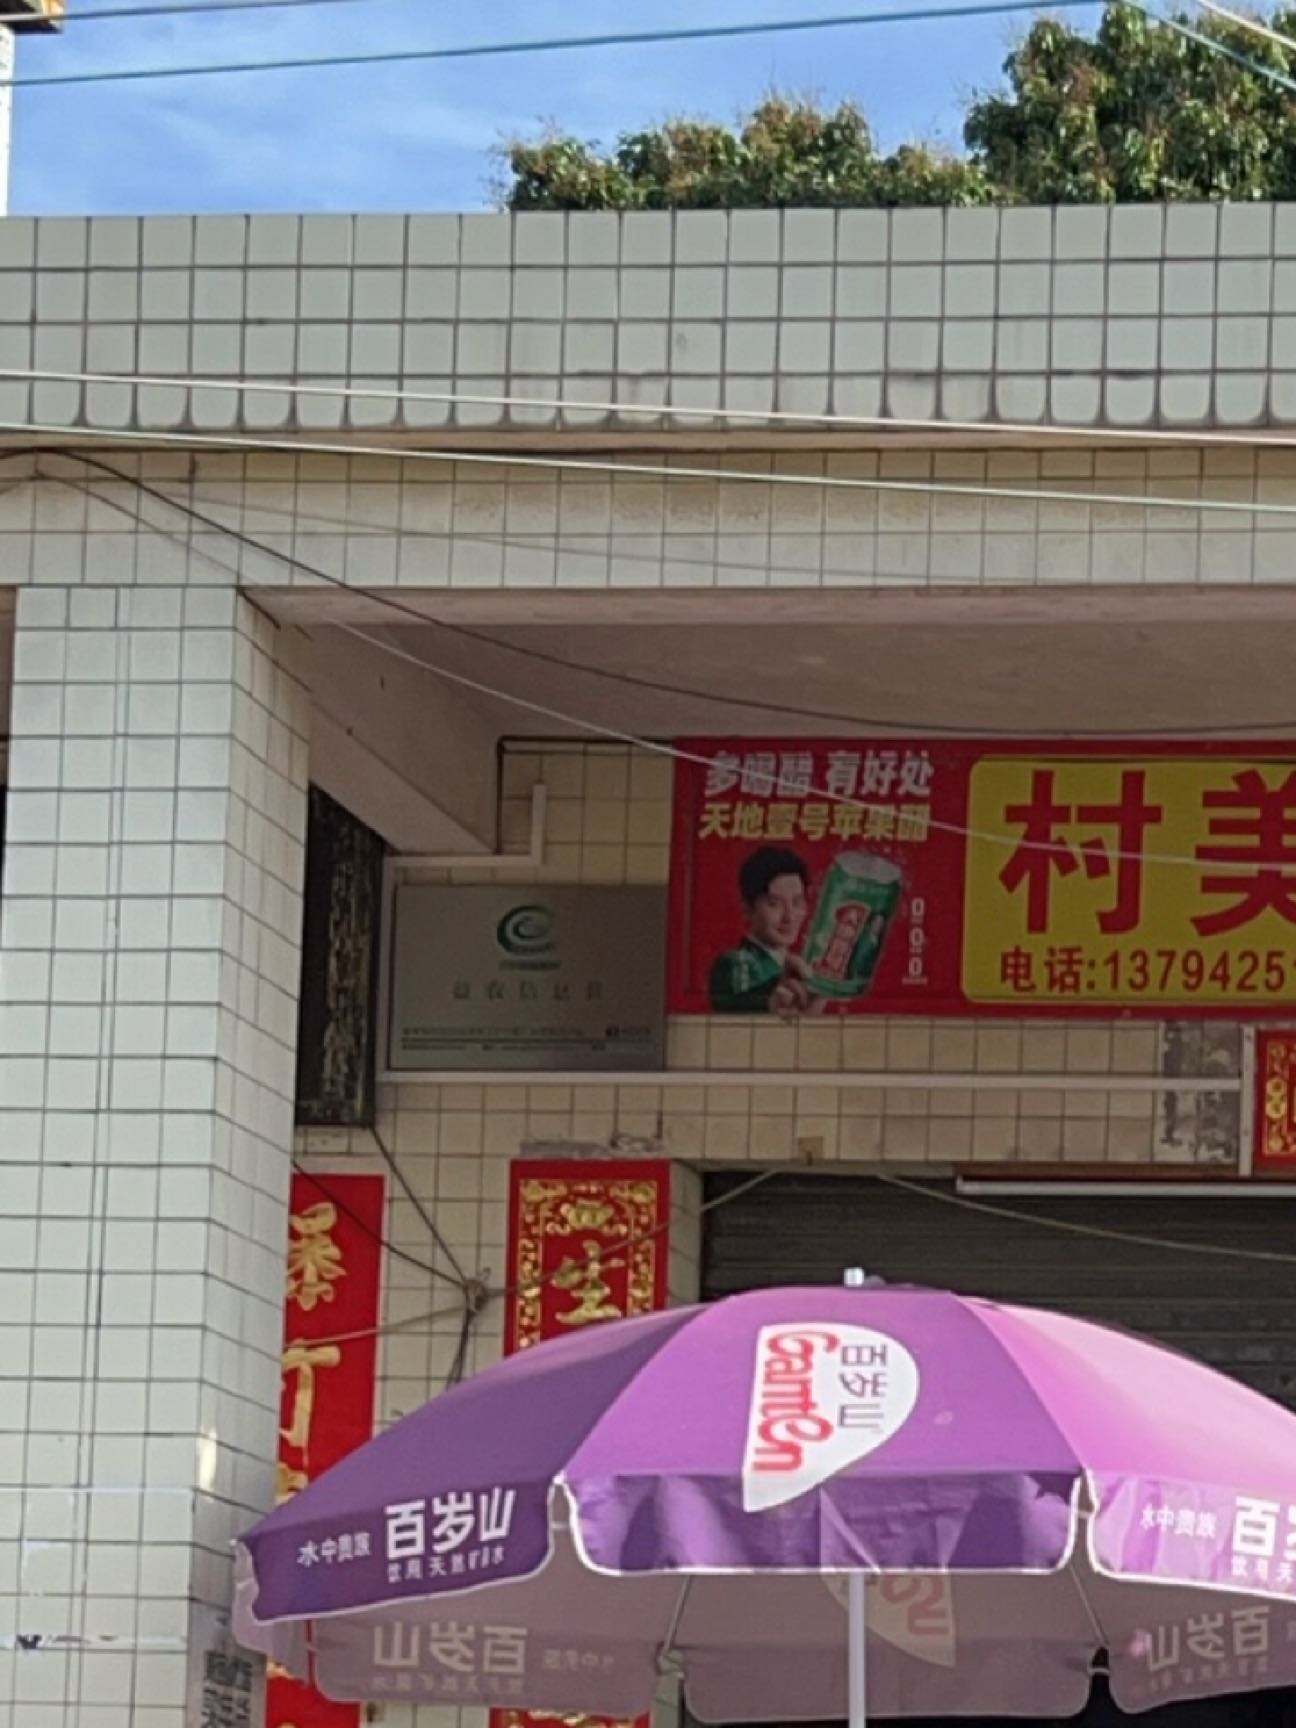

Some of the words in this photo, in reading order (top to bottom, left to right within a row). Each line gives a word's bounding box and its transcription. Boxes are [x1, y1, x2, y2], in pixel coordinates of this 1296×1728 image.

[826, 750, 934, 796] 有好处
[698, 801, 930, 841] 天地壹号苹果醋
[752, 1330, 840, 1472] Ganten
[838, 1344, 889, 1430] 百岁山
[297, 1532, 371, 1568] 水中贵族
[384, 1486, 516, 1559] 百岁山
[1140, 1505, 1216, 1539] 水中贵族
